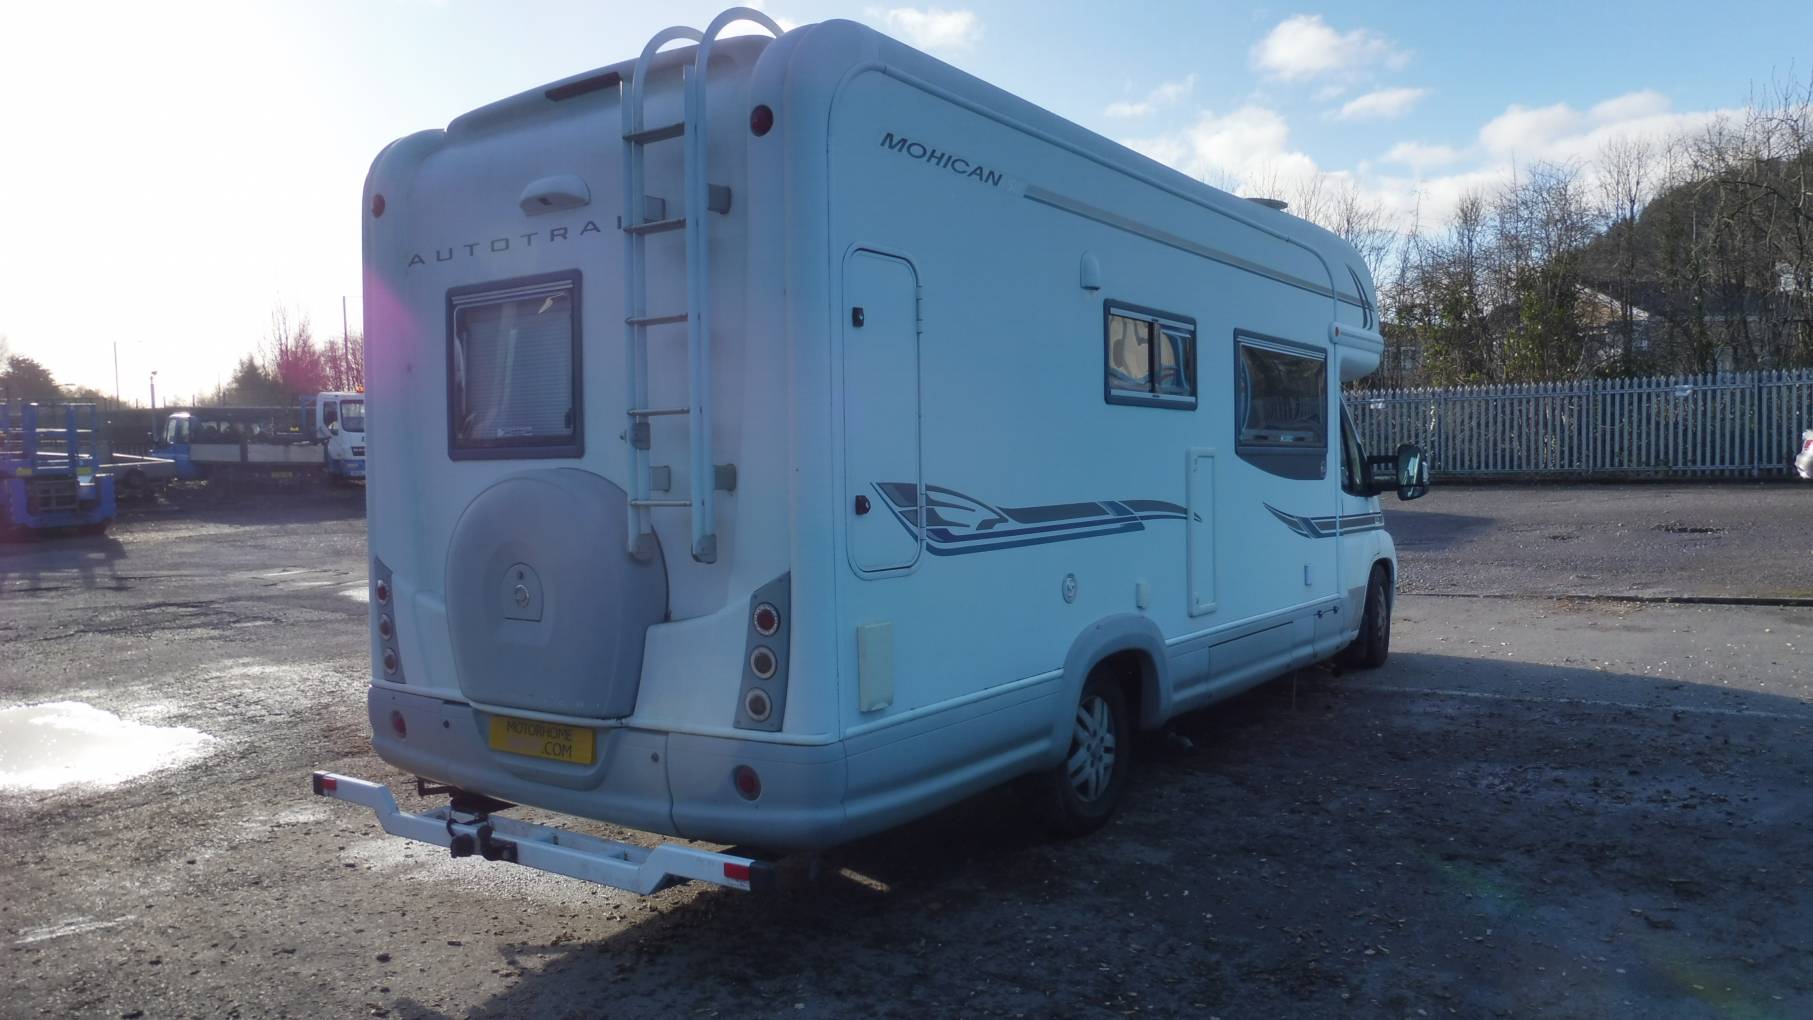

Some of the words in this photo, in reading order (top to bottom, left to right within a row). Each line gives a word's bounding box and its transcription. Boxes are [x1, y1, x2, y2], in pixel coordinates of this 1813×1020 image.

[880, 132, 1003, 187] MOHICAN
[408, 215, 623, 268] AUTOTRAI
[506, 720, 573, 742] MOTORHOME
[541, 740, 573, 759] .COM
